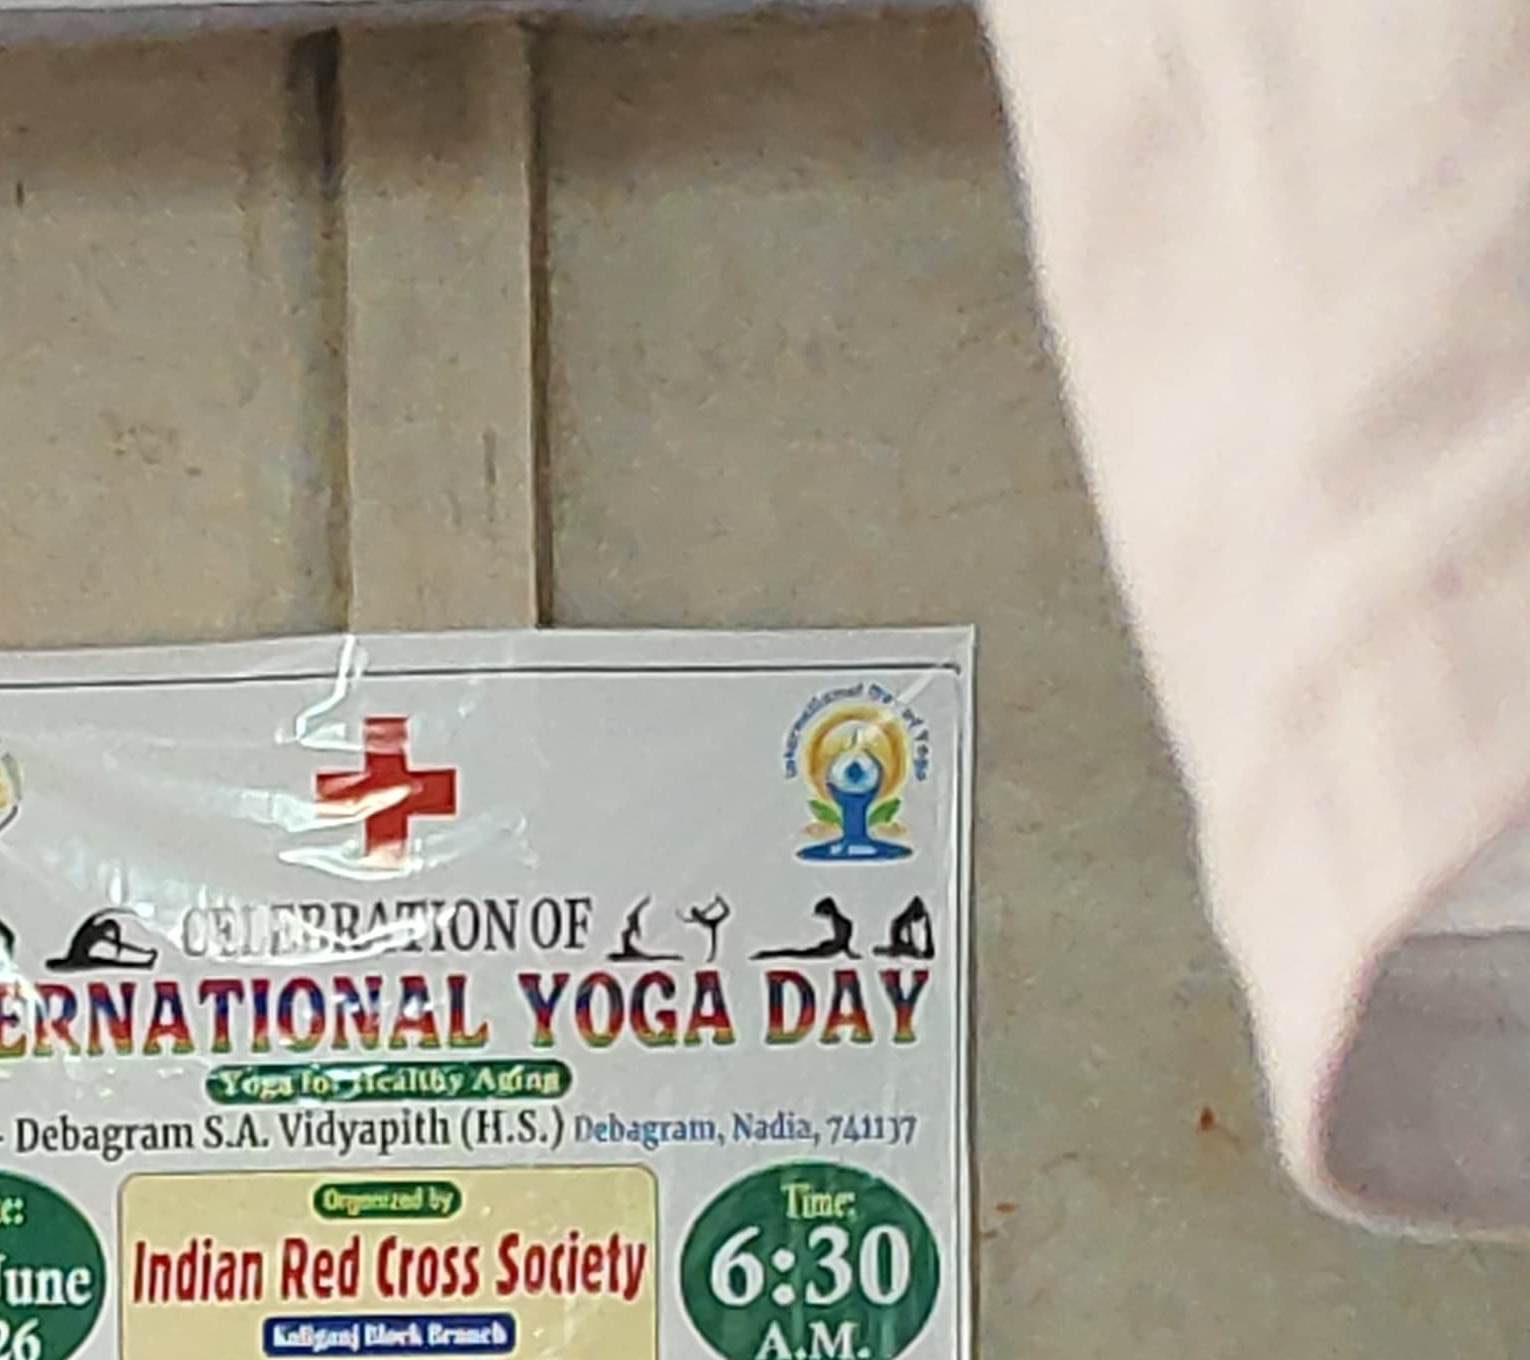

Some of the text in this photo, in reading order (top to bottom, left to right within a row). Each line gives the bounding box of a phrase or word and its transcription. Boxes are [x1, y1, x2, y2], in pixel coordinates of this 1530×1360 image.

[181, 897, 592, 957] CELEBRATION OF
[517, 970, 738, 1049] YOGA
[764, 968, 930, 1045] DAY
[220, 1069, 294, 1099] Yoga
[472, 1065, 561, 1095] Aging
[16, 1115, 193, 1162] Debagram
[203, 1116, 269, 1151] S.A.
[278, 1110, 449, 1157] Vidyapith
[461, 1105, 562, 1150] (H.S.)
[574, 1112, 725, 1149] Debagram,
[733, 1112, 819, 1146] Nadia,
[826, 1115, 916, 1146] 741137
[429, 1186, 453, 1213] by
[781, 1182, 857, 1220] Time:
[133, 1230, 646, 1302] Indian Red Cross Society
[710, 1224, 911, 1306] 6:30
[428, 1320, 508, 1346] Branch
